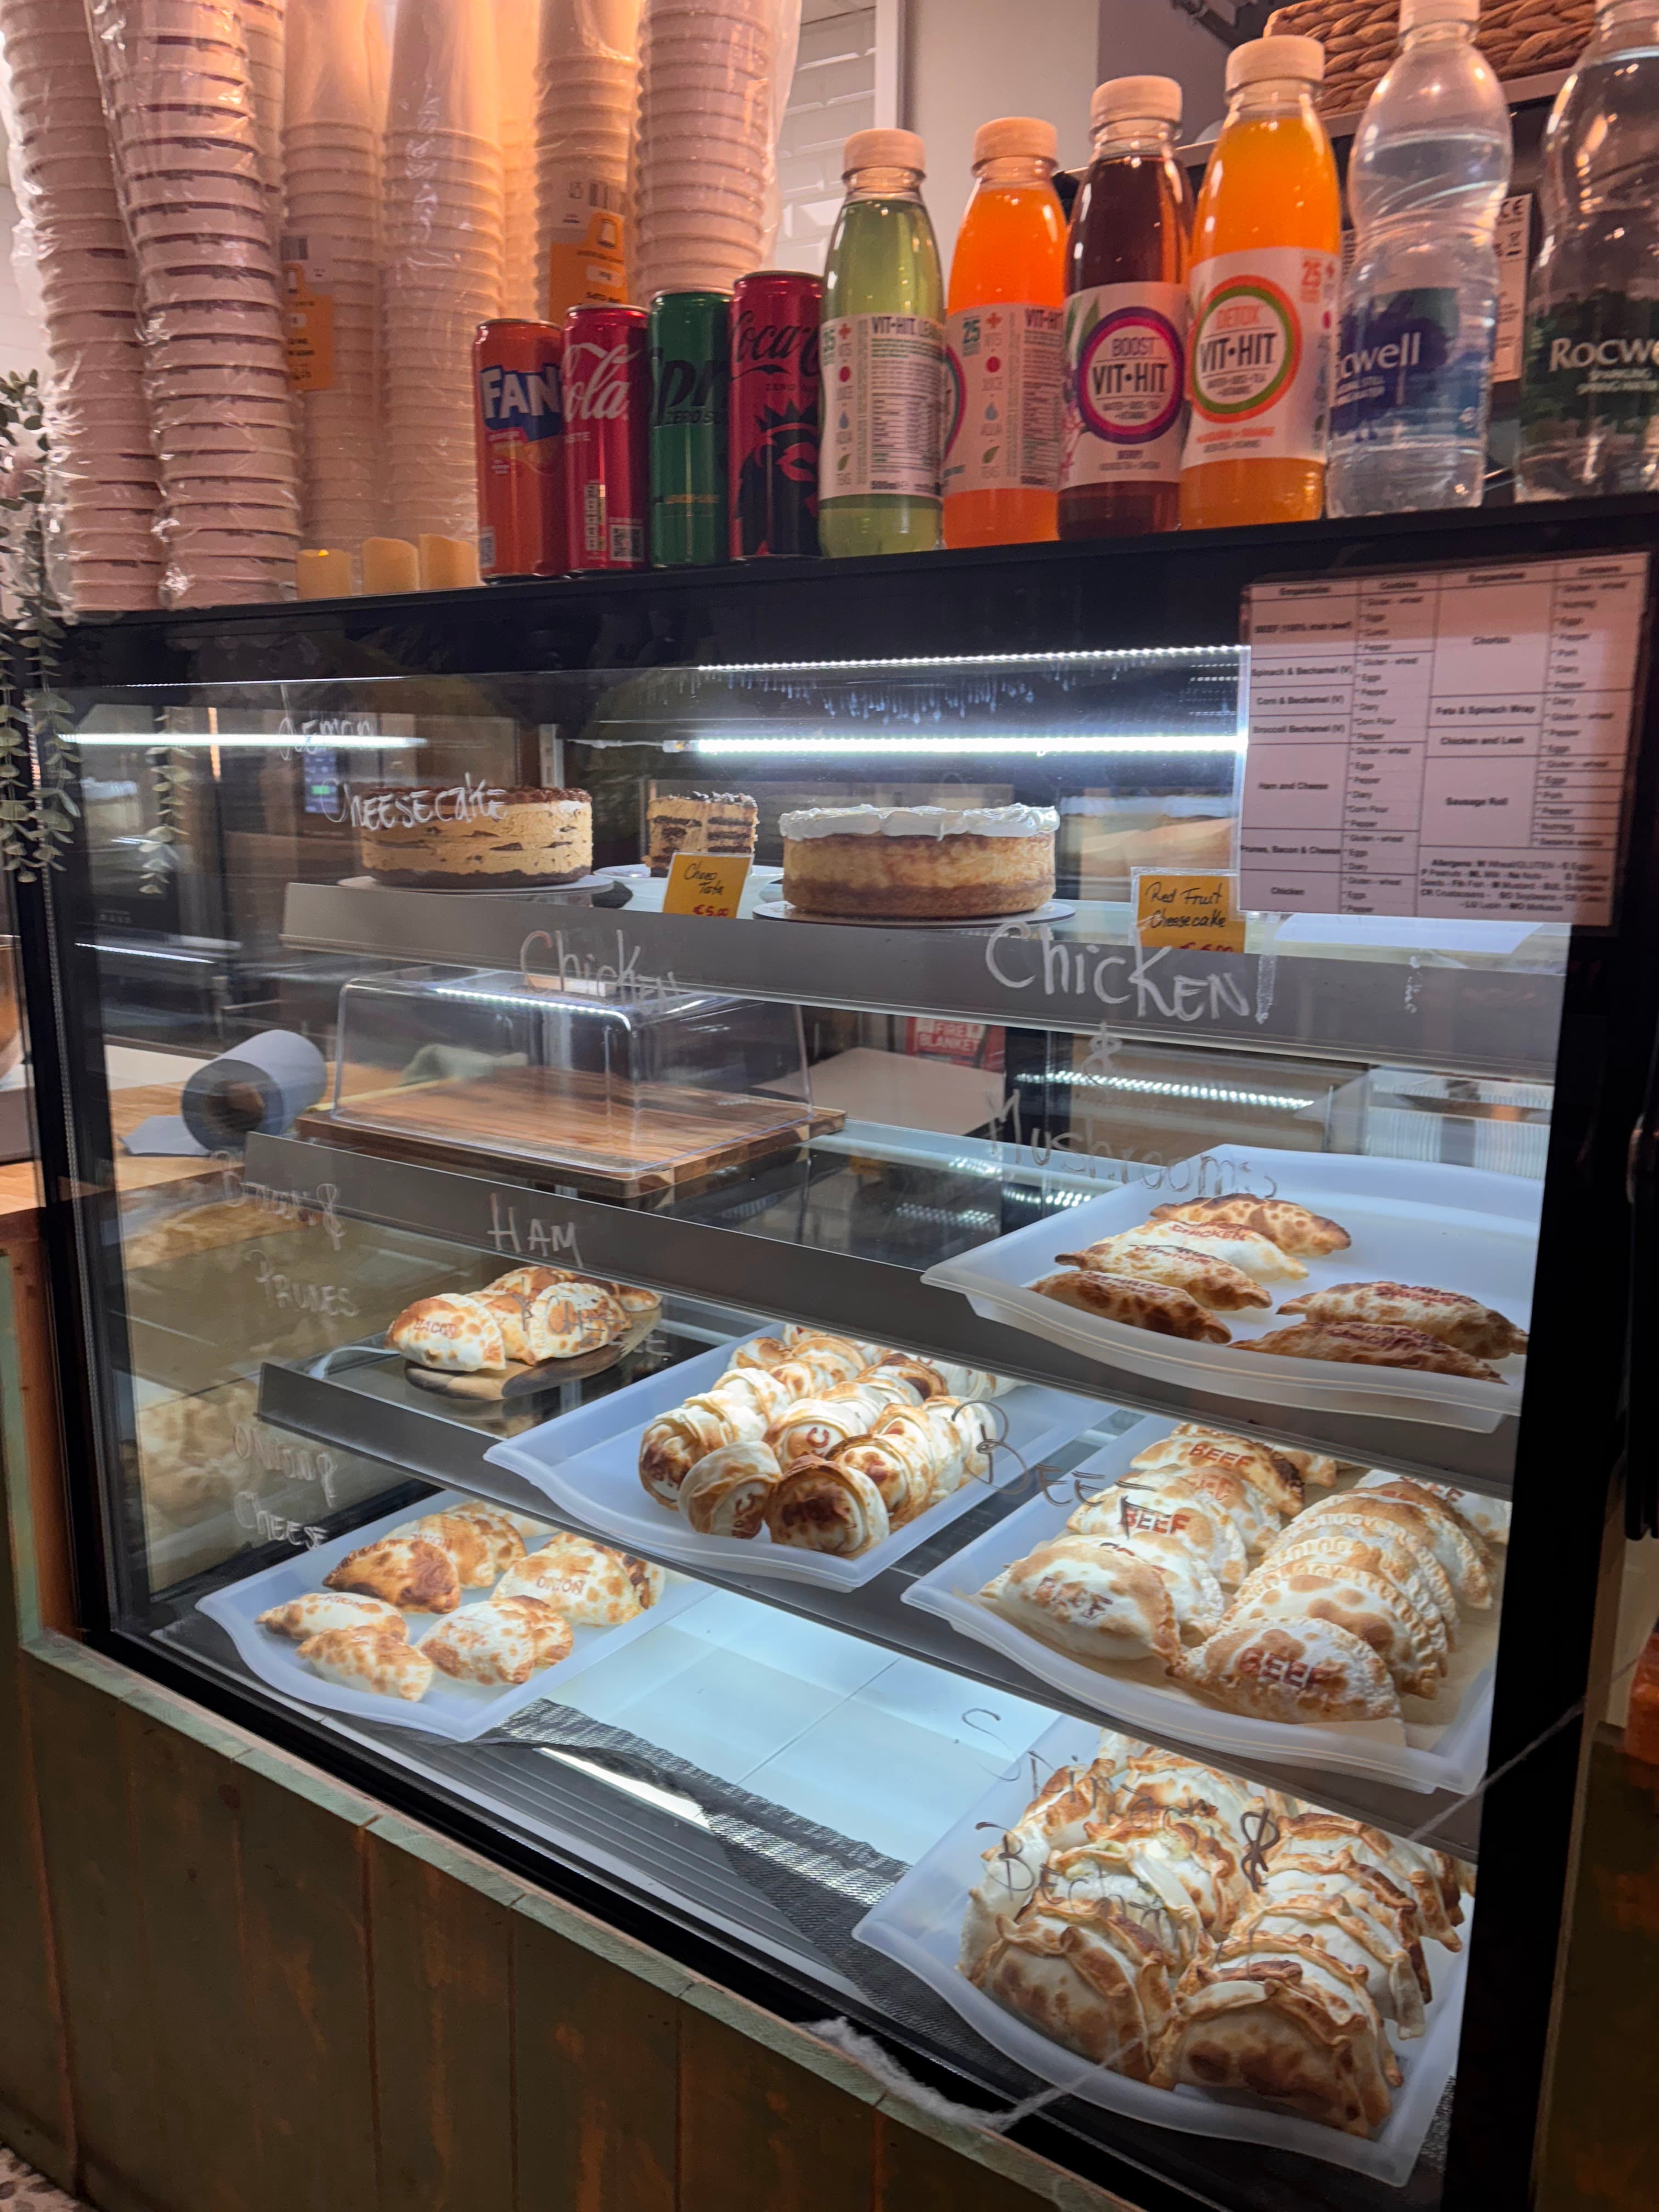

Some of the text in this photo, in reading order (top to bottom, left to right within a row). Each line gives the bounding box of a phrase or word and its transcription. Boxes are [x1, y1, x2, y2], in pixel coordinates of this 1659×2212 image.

[1335, 331, 1421, 380] cwell
[1144, 881, 1223, 905] Red Fruit
[1188, 1443, 1256, 1469] BEEF
[1121, 1505, 1191, 1534] BEEF
